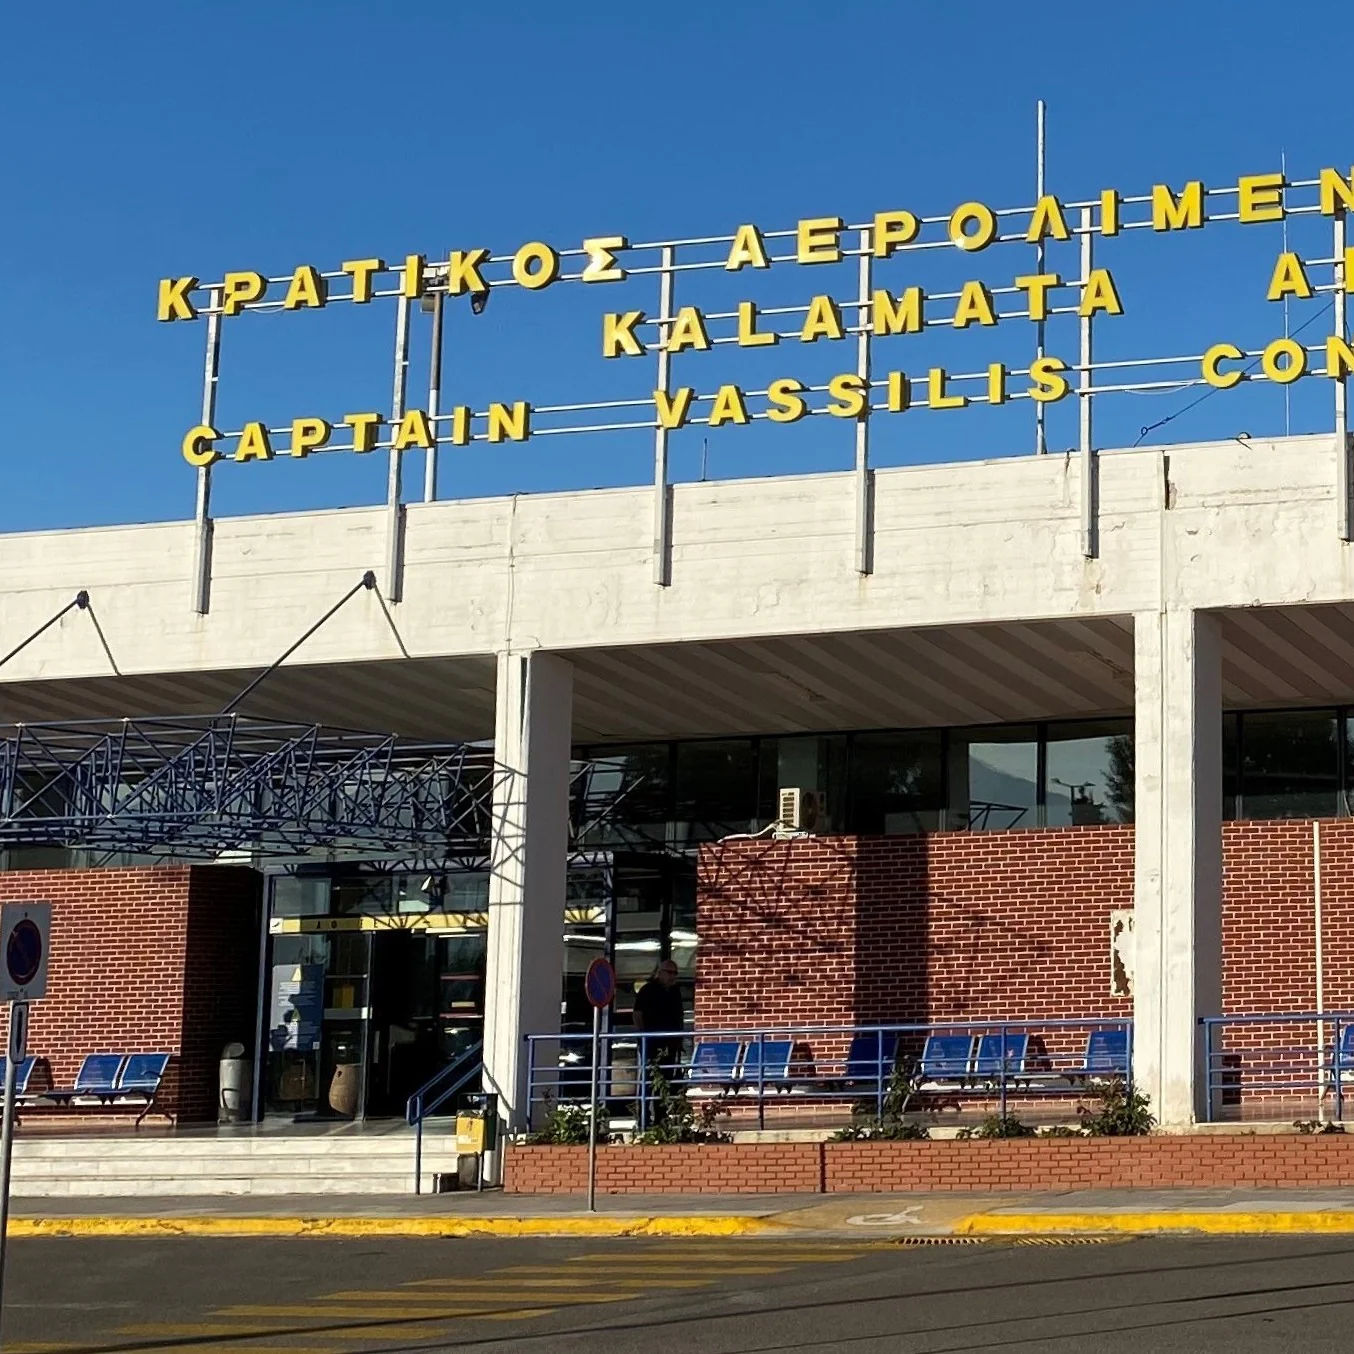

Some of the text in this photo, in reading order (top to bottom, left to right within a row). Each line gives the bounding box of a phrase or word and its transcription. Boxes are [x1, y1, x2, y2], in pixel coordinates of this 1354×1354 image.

[157, 236, 628, 321] ΚΡΑΤΙΚΟΣ
[602, 268, 1122, 359] KALAMATA
[182, 401, 530, 469] CAPTAIN
[652, 356, 1070, 431] VASSILIS
